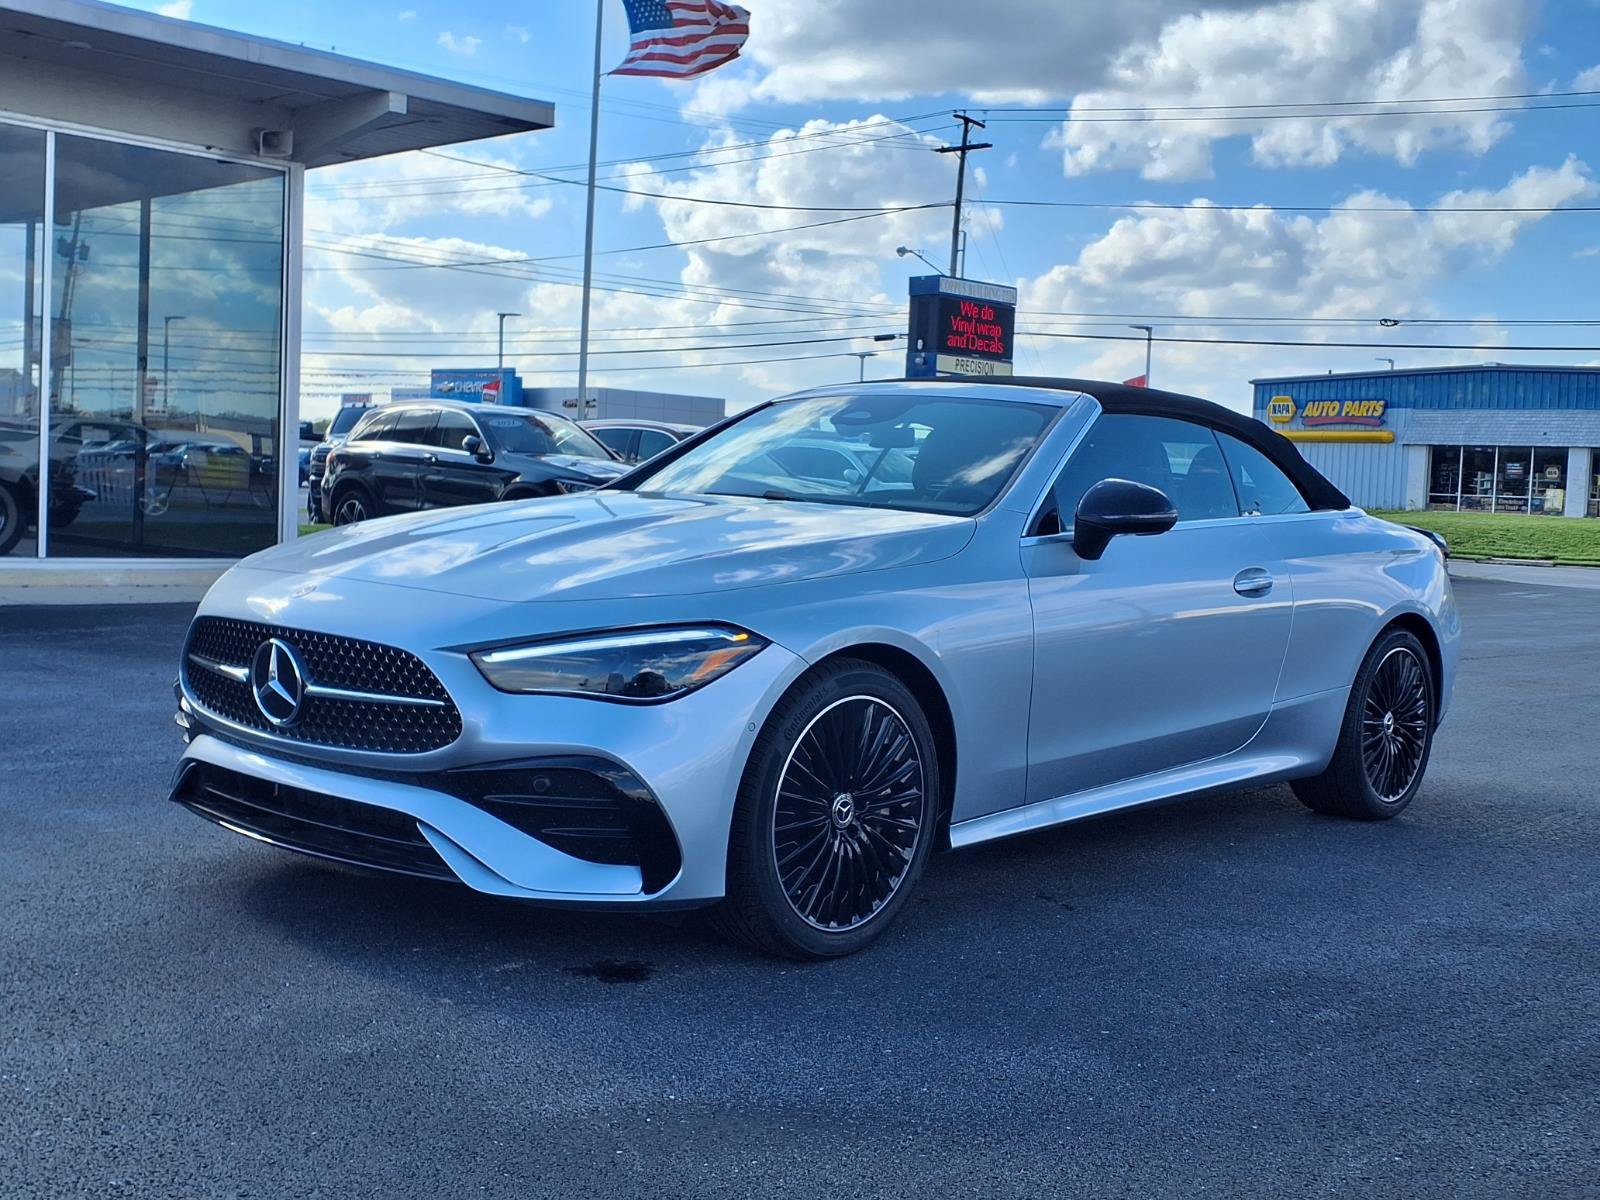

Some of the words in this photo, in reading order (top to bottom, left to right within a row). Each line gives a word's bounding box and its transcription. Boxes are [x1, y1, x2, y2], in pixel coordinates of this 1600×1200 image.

[960, 301, 979, 318] We
[981, 305, 995, 321] do
[951, 315, 975, 336] Vinyl
[976, 323, 1002, 338] wrap
[947, 334, 968, 349] and
[969, 335, 1004, 354] Decals
[954, 358, 995, 376] PRECISION
[1271, 403, 1290, 415] NAPA
[1303, 401, 1340, 417] AUTO
[1341, 400, 1385, 417] PARTS
